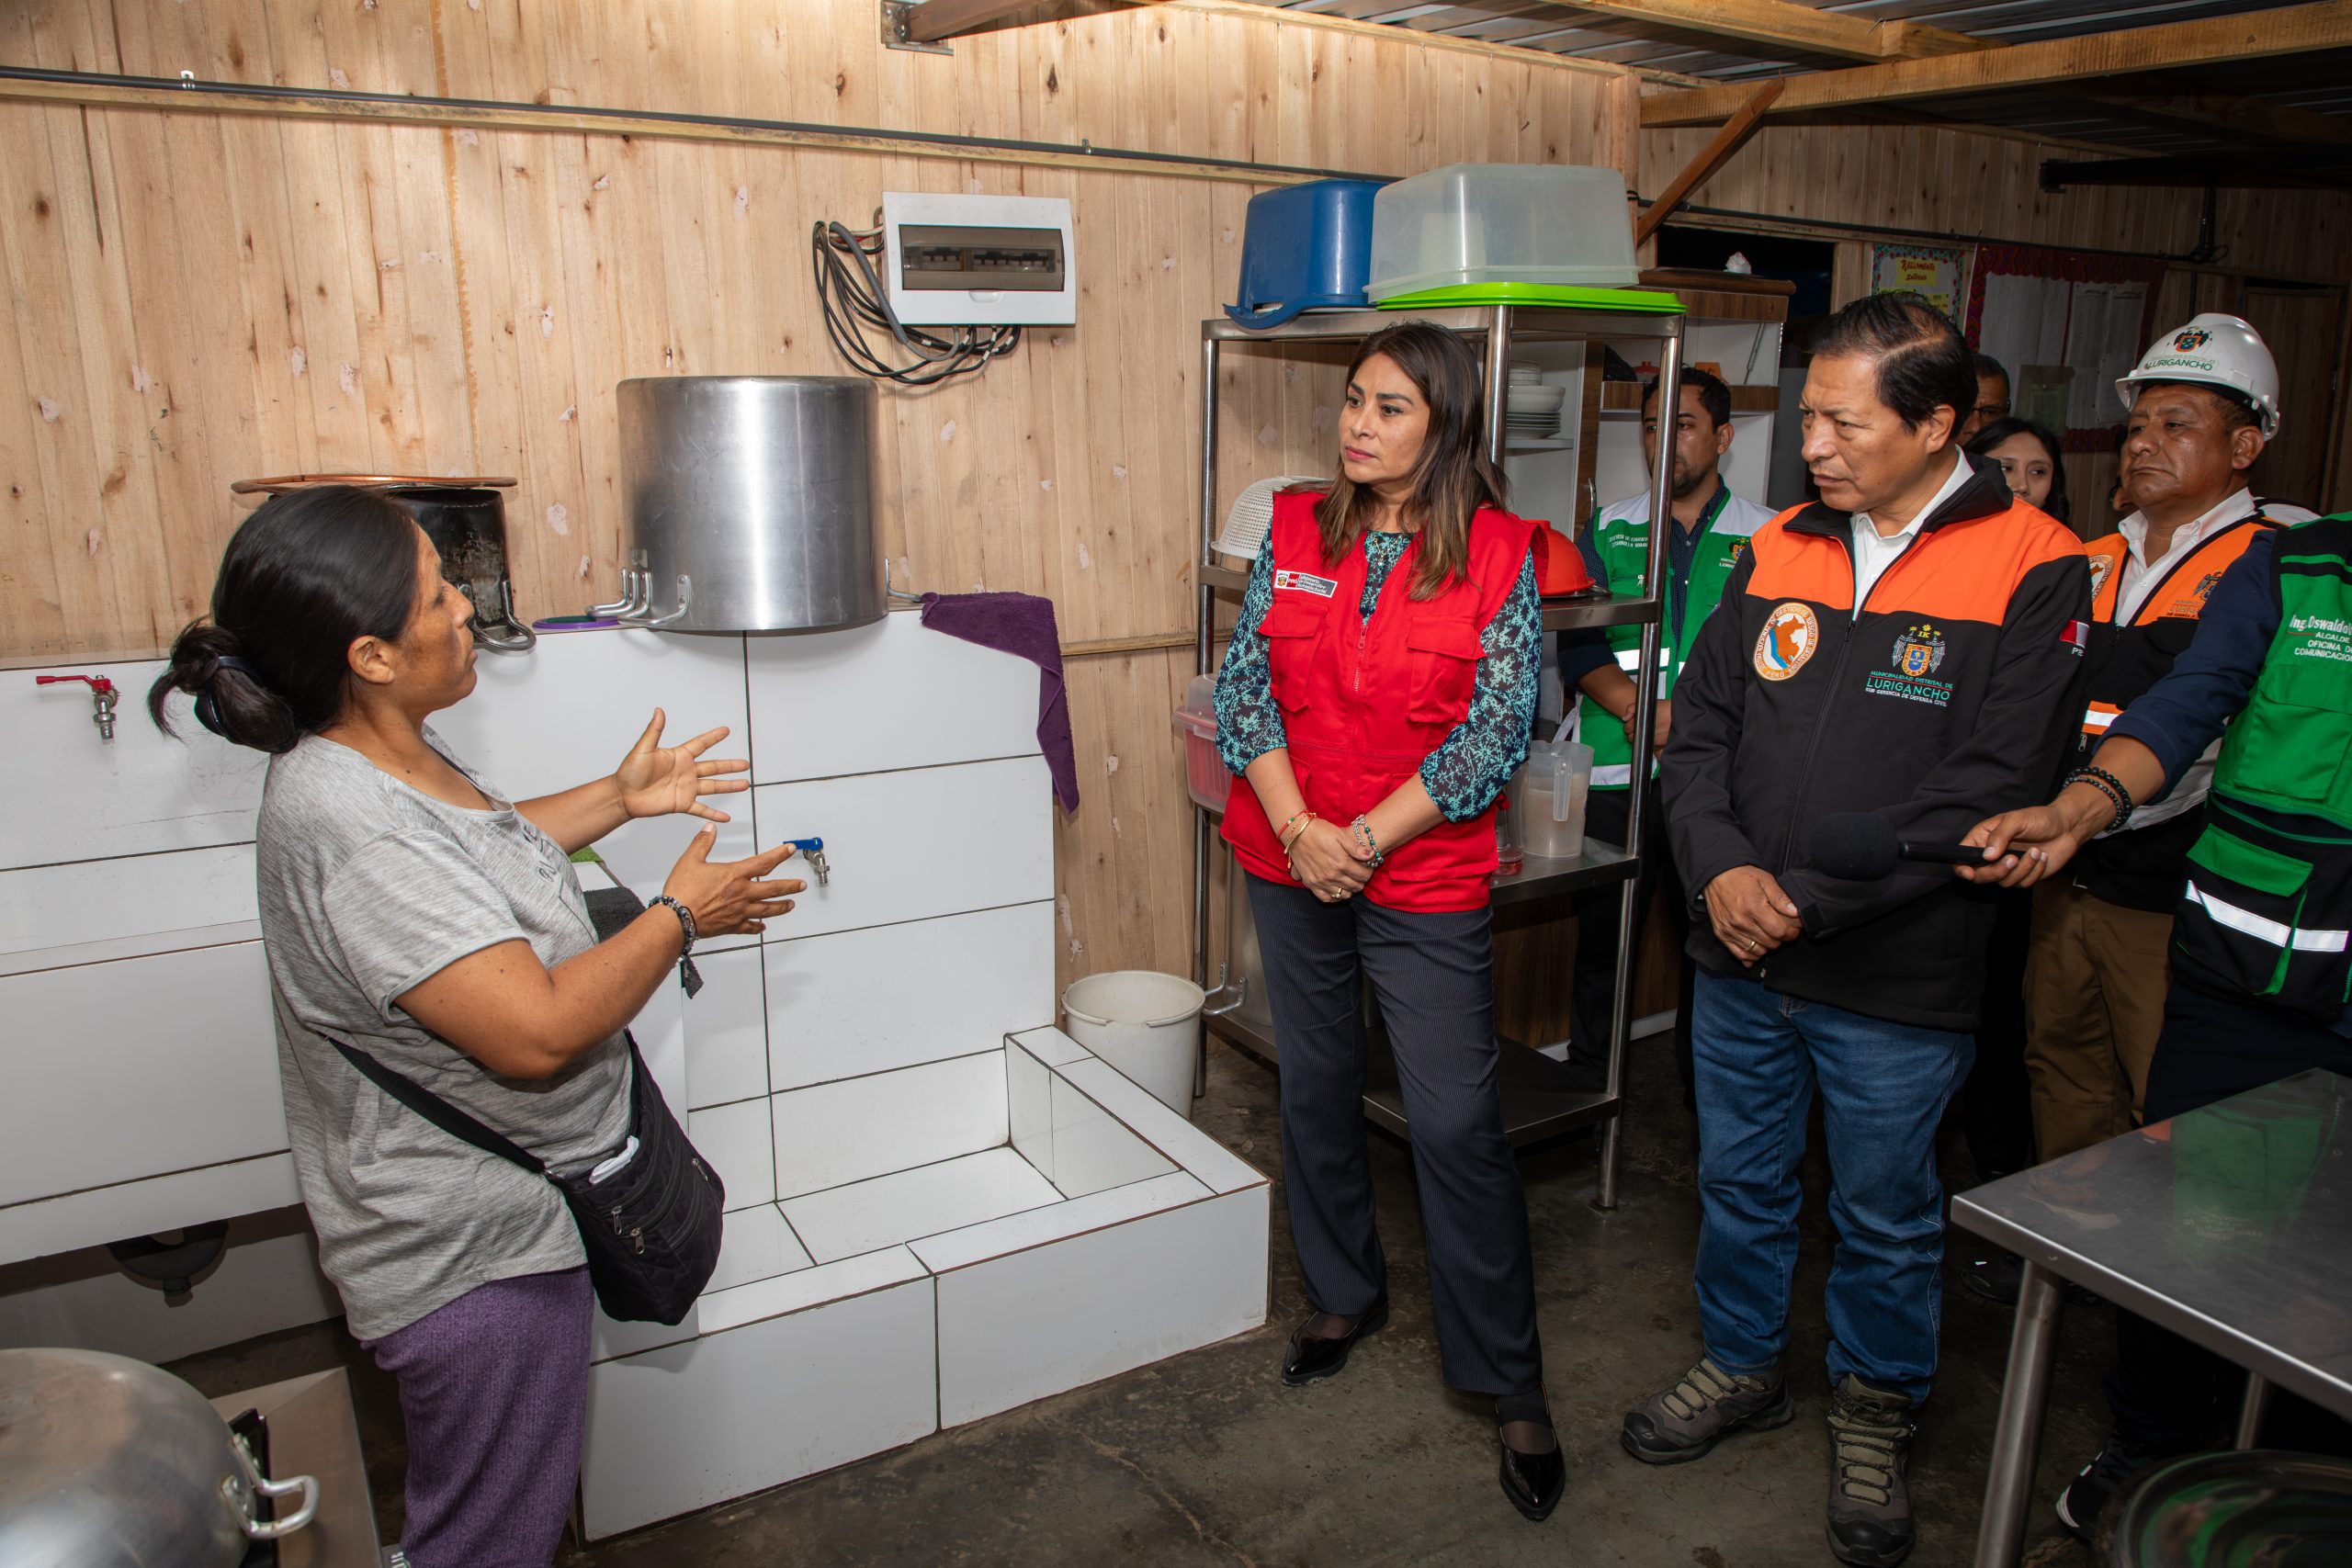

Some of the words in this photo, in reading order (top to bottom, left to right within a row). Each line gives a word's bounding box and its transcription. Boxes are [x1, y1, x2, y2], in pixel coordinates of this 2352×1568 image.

[2308, 615, 2348, 634] Oswaldo
[2307, 639, 2341, 651] OFICINA
[2315, 631, 2350, 643] ALCALDE
[1870, 671, 1913, 682] MUNICIPALIDAD
[1915, 677, 1943, 688] DISTRITAL
[1866, 677, 1951, 700] LURIGANCHO
[1876, 689, 1901, 697] GERENCIA
[1909, 694, 1933, 704] DEFENSA
[1934, 699, 1948, 707] CIVIL
